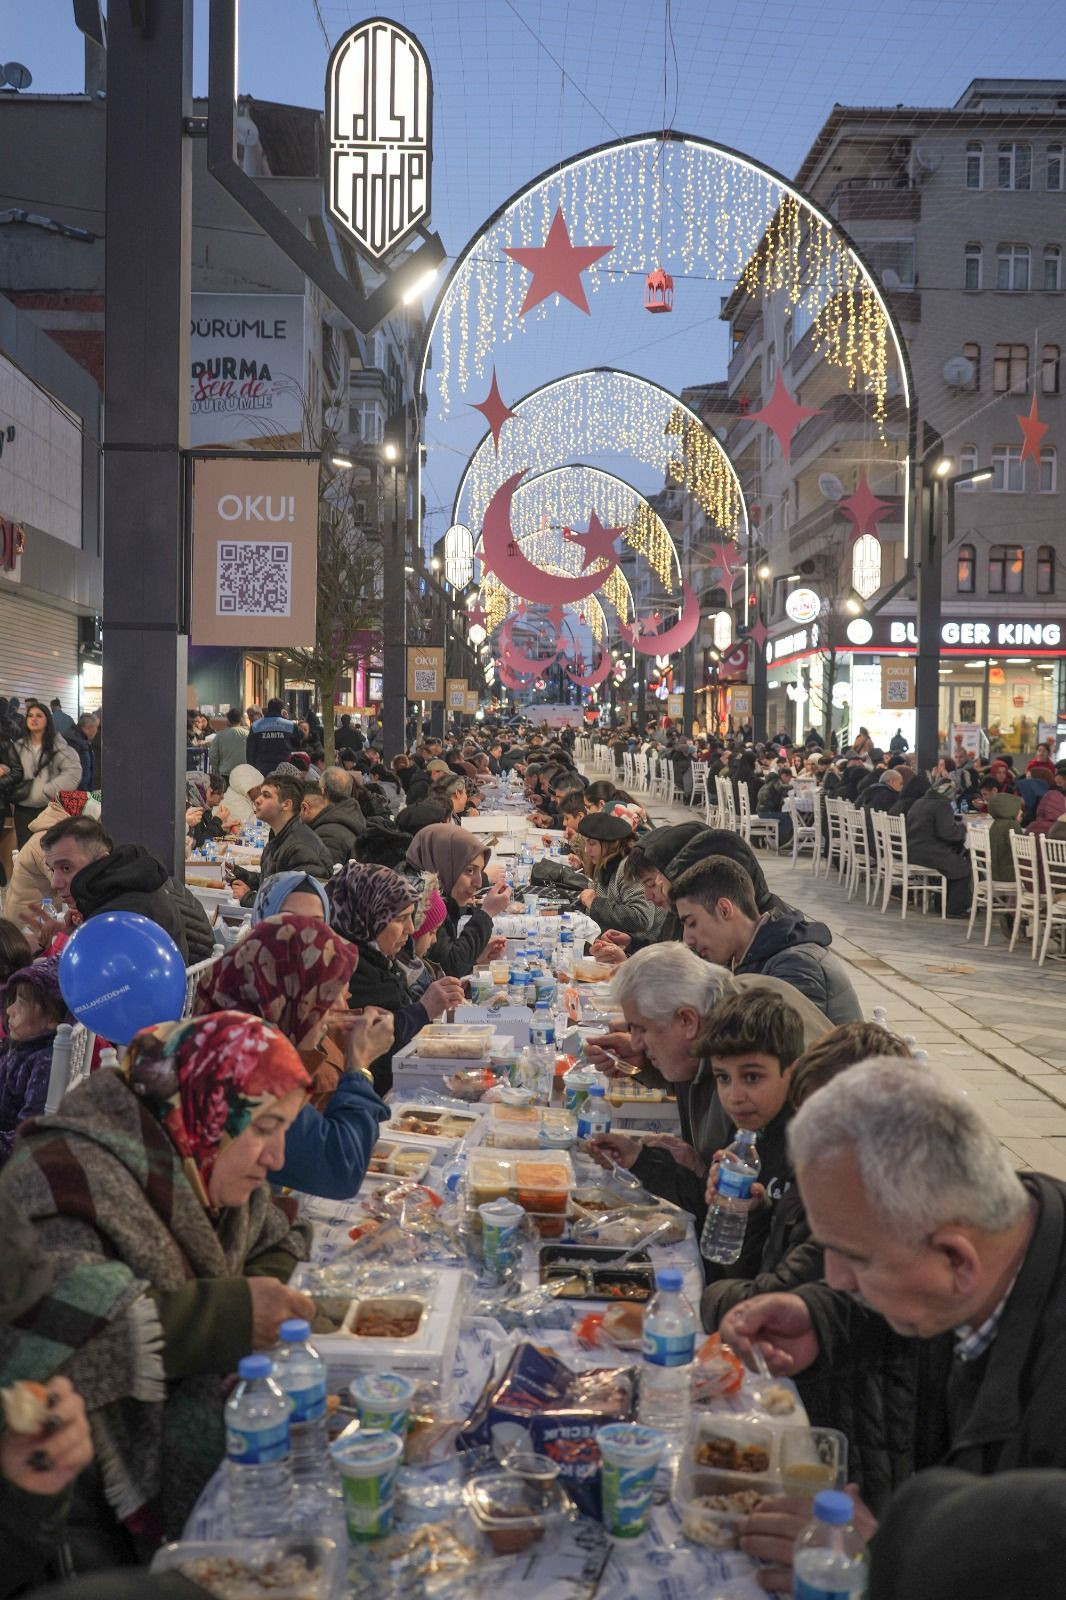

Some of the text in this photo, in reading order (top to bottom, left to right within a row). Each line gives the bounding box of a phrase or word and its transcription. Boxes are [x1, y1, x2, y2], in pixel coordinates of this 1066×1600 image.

[192, 357, 272, 381] DURMA
[217, 494, 295, 522] OKU!
[890, 622, 1061, 646] BUGER KING
[415, 656, 438, 665] OKU!
